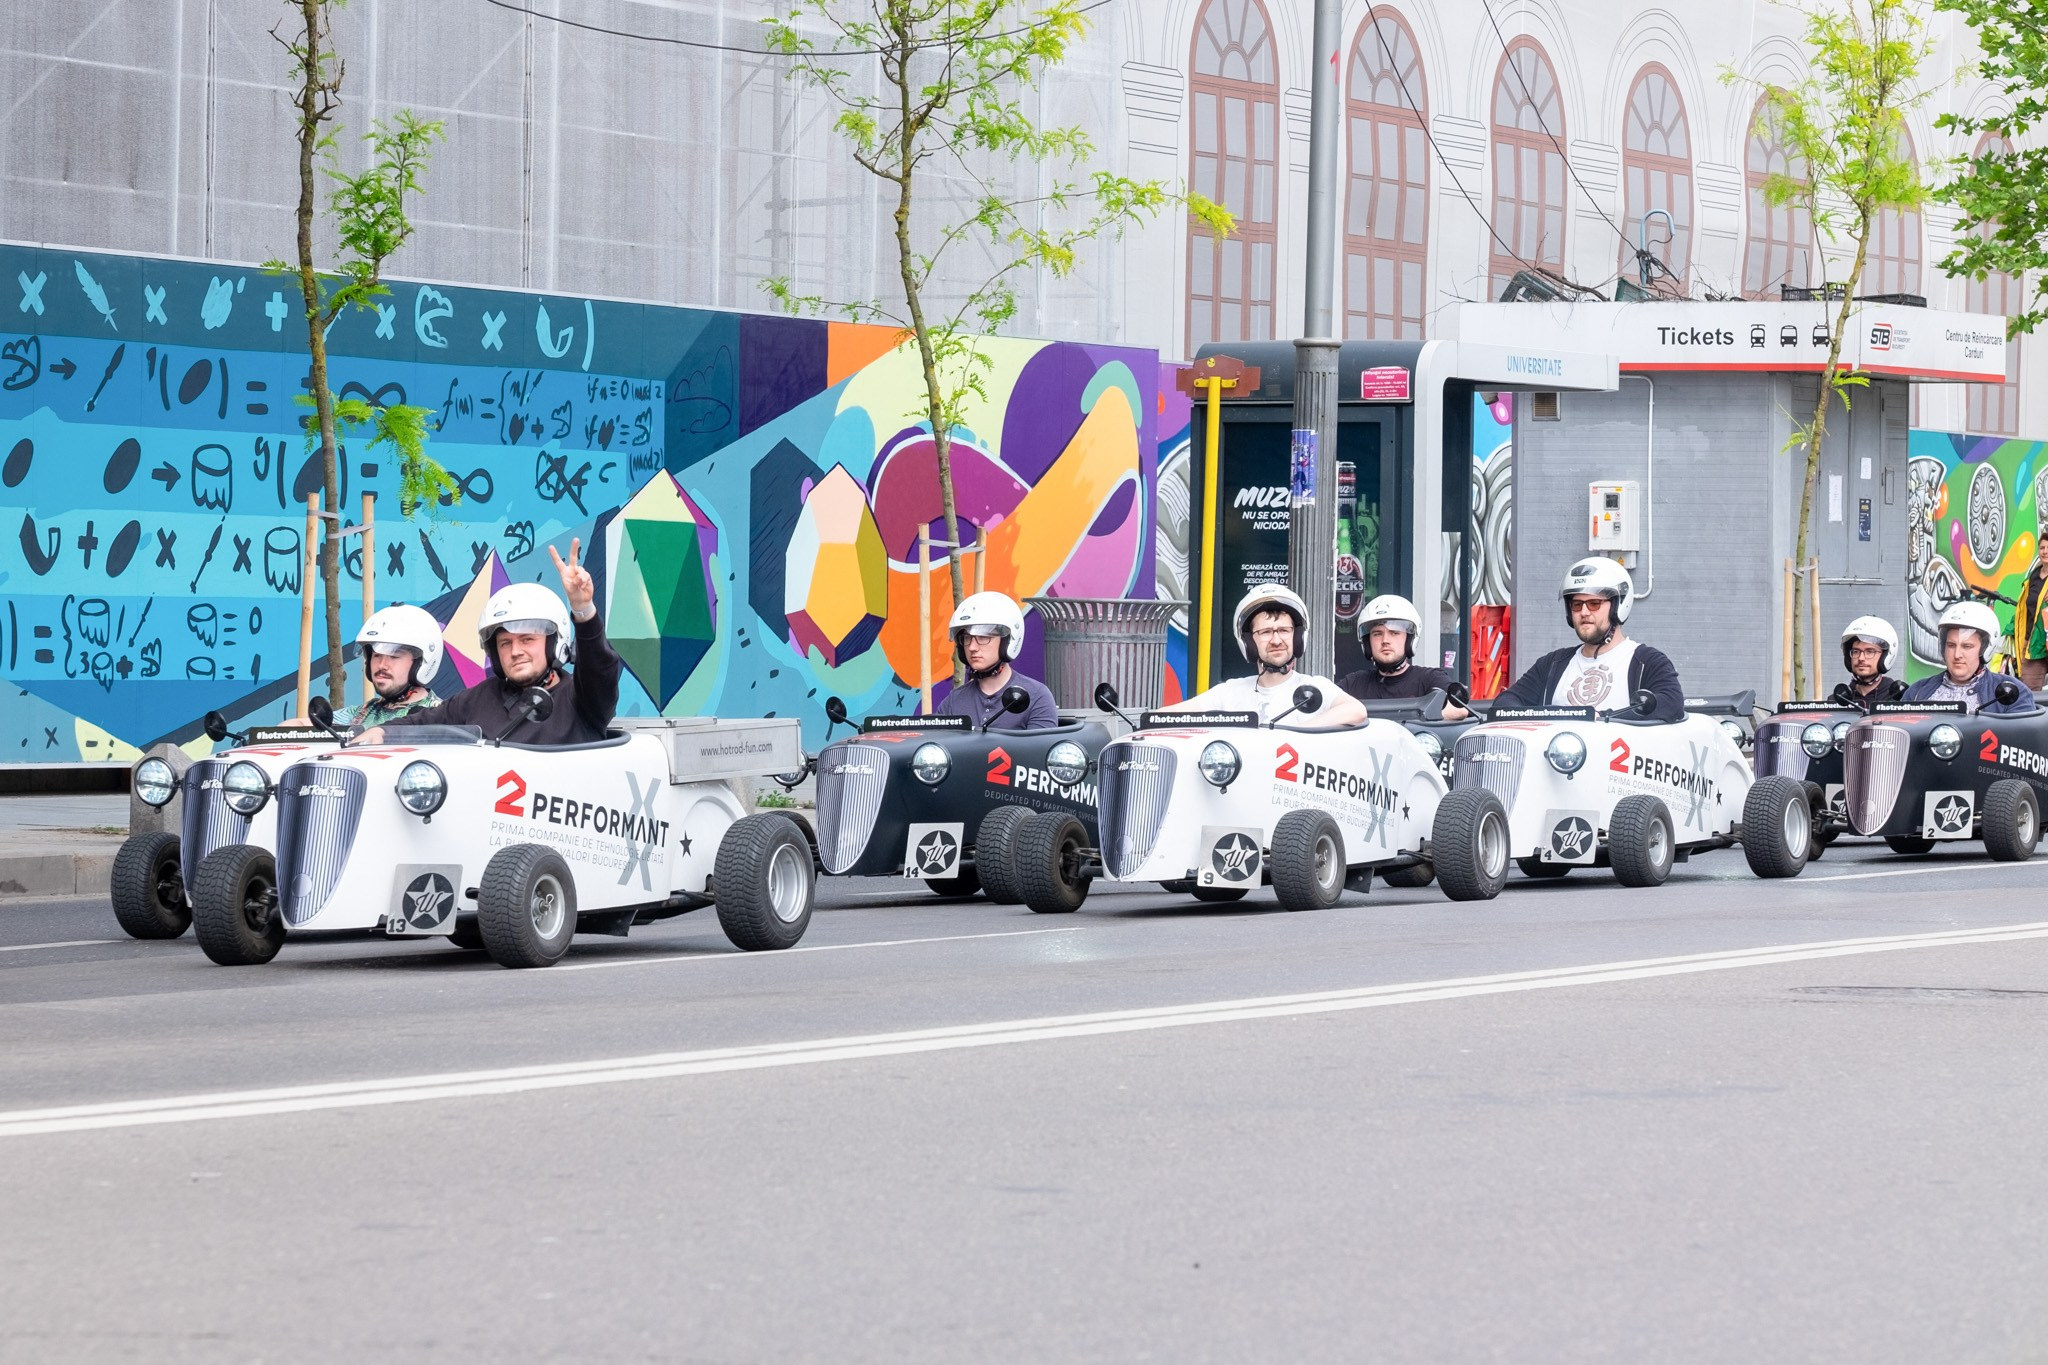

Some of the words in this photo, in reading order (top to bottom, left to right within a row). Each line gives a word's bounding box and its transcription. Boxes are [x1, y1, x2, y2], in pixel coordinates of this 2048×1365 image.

[1657, 327, 1734, 346] Tickets
[1870, 328, 1891, 346] STB
[1945, 328, 1964, 342] Centru
[1964, 331, 1972, 343] de
[1964, 346, 1984, 359] Carduri
[1506, 355, 1562, 377] UNIVERSITATE
[1242, 511, 1256, 520] NU
[1257, 511, 1270, 520] SE
[1270, 511, 1290, 520] OPR
[1336, 580, 1364, 591] ECK'S
[1495, 709, 1587, 718] #hotrodfunbucharest
[1876, 703, 1959, 711] #hotrodfunbucharest
[871, 717, 963, 727] #hotrodfunbucharest
[1149, 714, 1249, 724] #hotrodfunbucharest
[256, 730, 355, 740] #hotrodfunbuchrest
[700, 741, 773, 757] www.hotrod-fun.com
[1980, 728, 1999, 763] 2
[986, 746, 1012, 786] 2
[1609, 737, 1631, 774] 2
[1633, 755, 1714, 800] PERFORMANT
[1978, 765, 2011, 779] DEDICATED
[1275, 742, 1299, 783] 2
[1303, 762, 1399, 813] PERFORMANT
[1608, 774, 1631, 787] PRIMA
[984, 789, 1029, 805] DEDICATED
[1032, 798, 1041, 808] TO
[1271, 796, 1281, 805] LA
[1273, 783, 1299, 798] PRIMA
[1301, 790, 1339, 808] COMPANIE
[494, 769, 527, 817] 2
[531, 792, 670, 848] PERFORMANT
[1927, 828, 1935, 838] 2
[491, 821, 526, 837] PRIMA
[528, 827, 581, 846] COMPANIE
[582, 837, 594, 849] DE
[596, 839, 640, 860] TEHNOLOGIE
[489, 835, 501, 847] LA
[559, 847, 591, 863] VALORI
[1544, 849, 1552, 861] 4
[905, 866, 919, 878] 14
[1203, 872, 1214, 885] 9
[388, 918, 407, 933] 13
